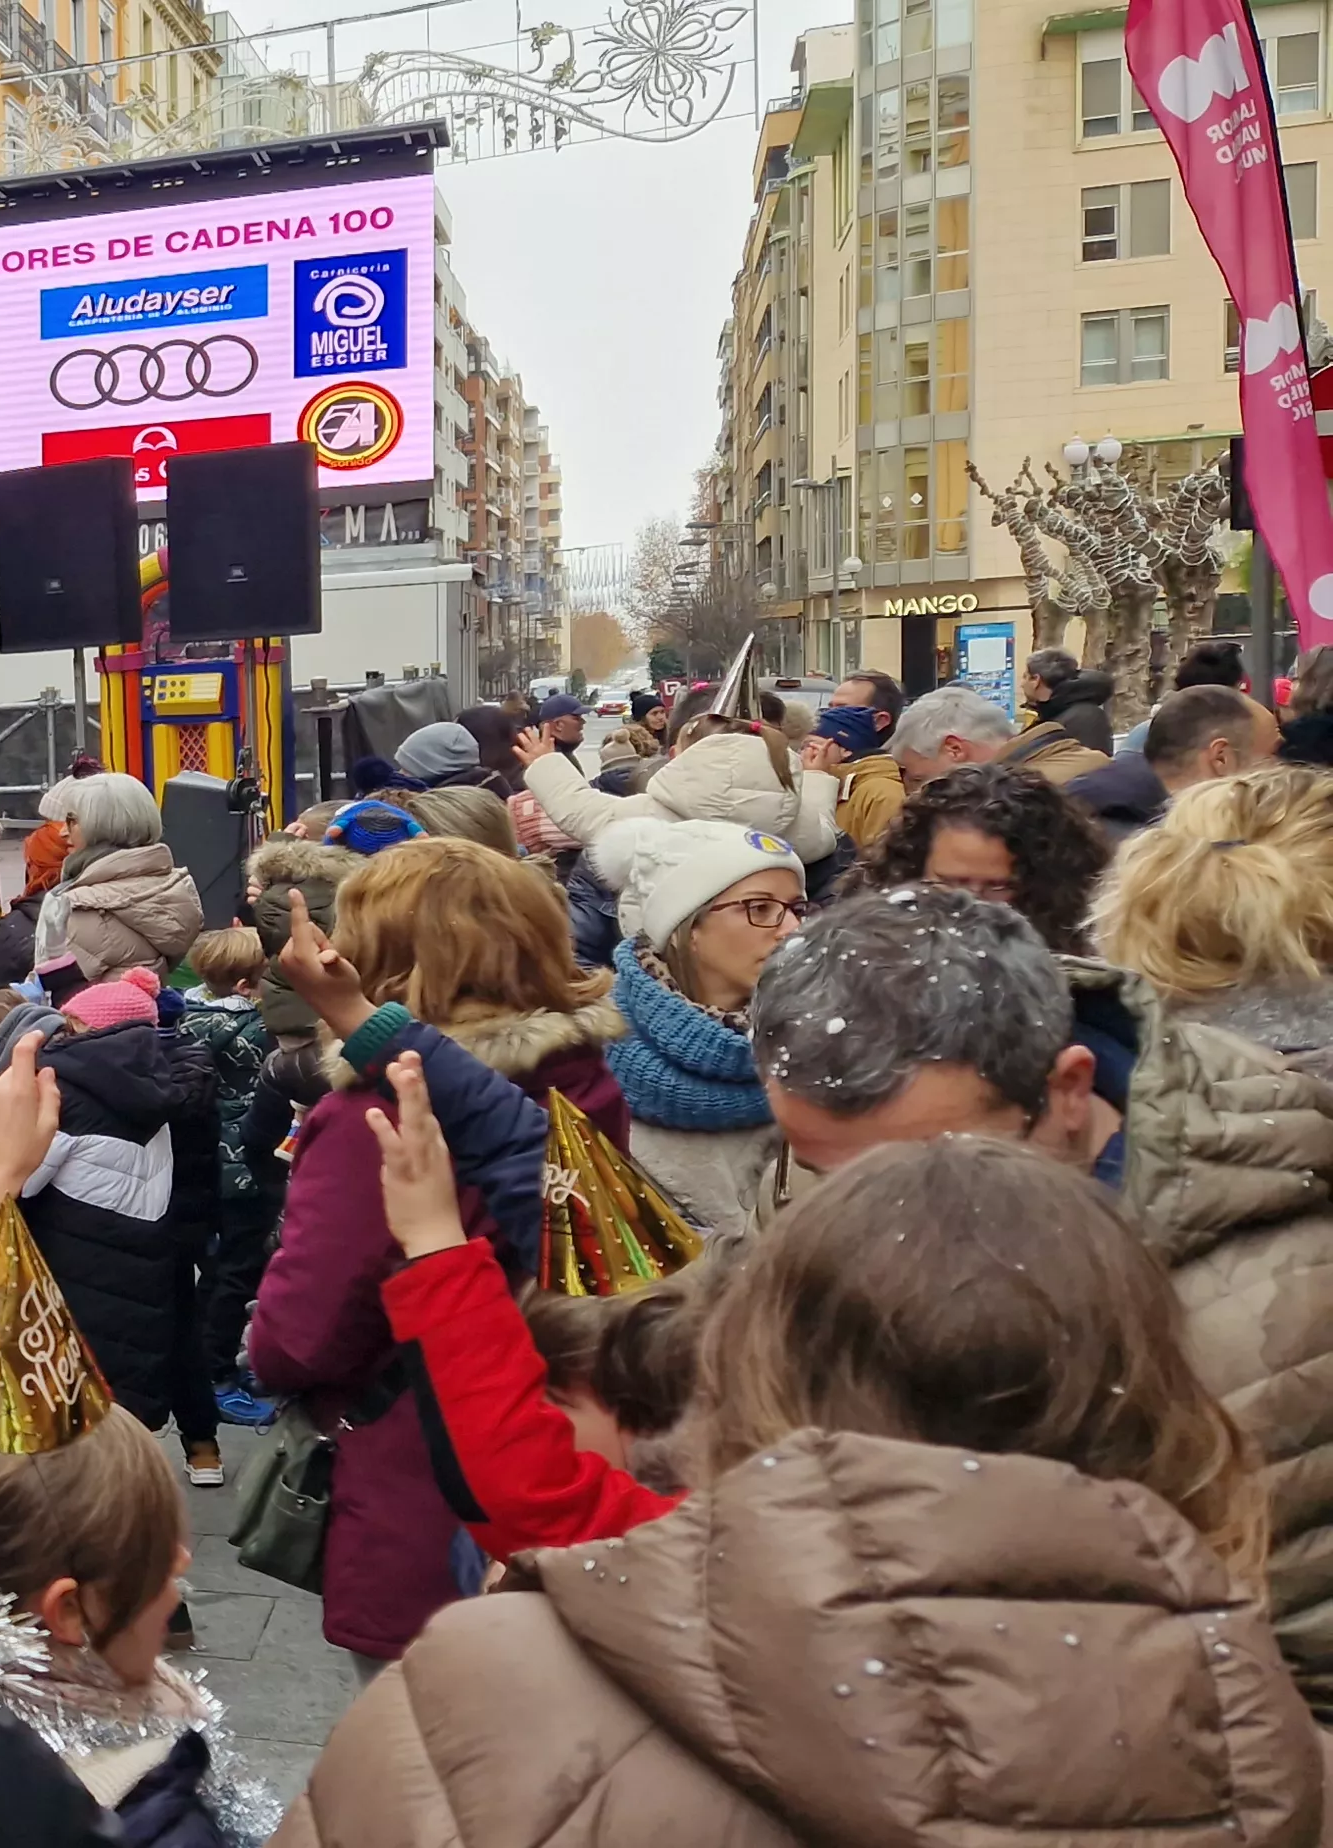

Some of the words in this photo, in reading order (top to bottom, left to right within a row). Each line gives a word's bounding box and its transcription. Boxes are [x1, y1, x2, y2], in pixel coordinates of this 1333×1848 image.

[107, 234, 154, 261] DE
[165, 216, 317, 253] CADENA
[329, 206, 394, 235] 100
[71, 284, 235, 319] Aludayser
[311, 325, 388, 356] MIGUEL
[310, 350, 388, 368] ESCUER
[328, 456, 373, 468] sonido
[884, 593, 978, 617] MANGO
